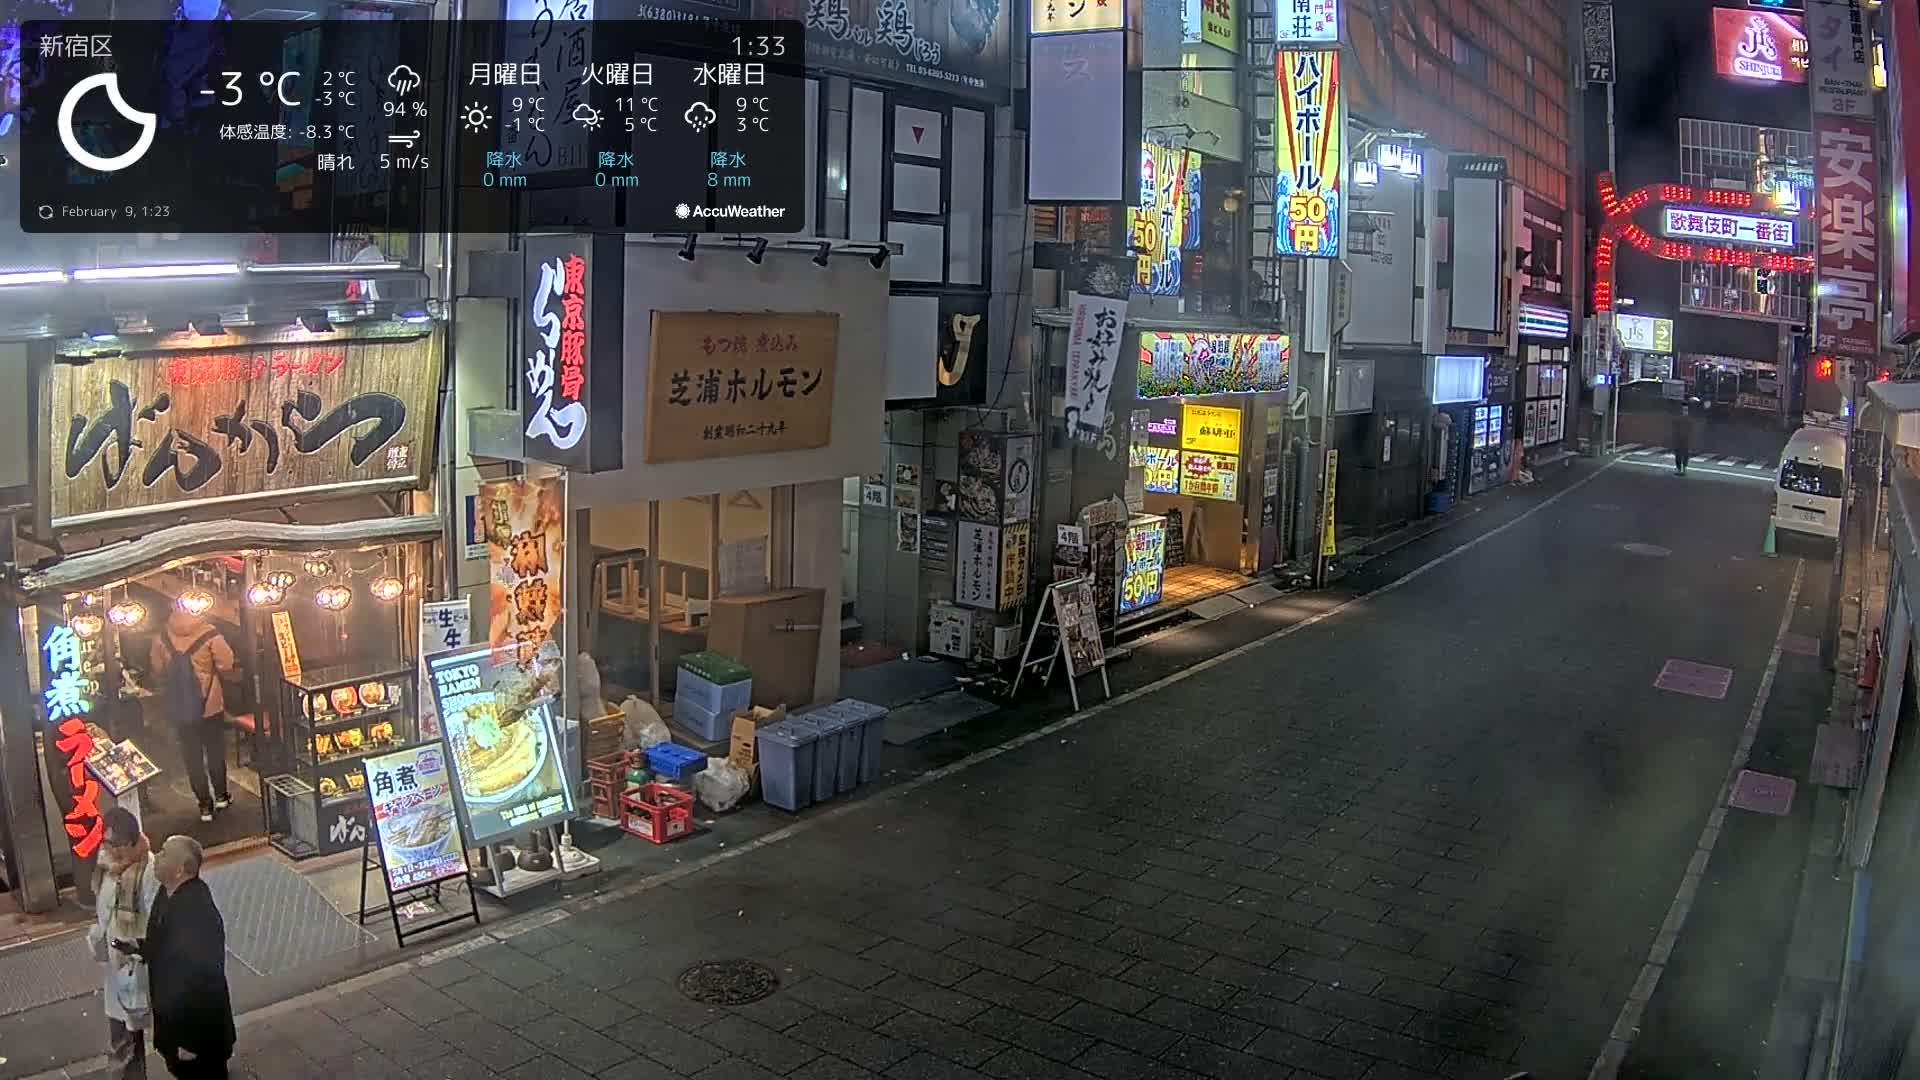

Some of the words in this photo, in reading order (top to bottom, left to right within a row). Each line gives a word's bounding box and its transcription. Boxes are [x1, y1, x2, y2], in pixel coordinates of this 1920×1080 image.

[1589, 65, 1609, 79] 7F
[1296, 54, 1321, 190] ハイボール
[1290, 196, 1327, 223] 50
[1670, 212, 1789, 242] 歌舞伎町一番街
[1295, 224, 1319, 252] 円
[1819, 127, 1875, 330] 安楽亭
[560, 254, 585, 400] 東京豚骨
[669, 367, 823, 407] 芝浦ホルモン
[65, 378, 407, 493] ばんから
[43, 626, 92, 720] 角煮
[435, 663, 480, 685] TOKYO
[438, 676, 482, 697] RAMEN
[55, 718, 104, 858] ラーメン
[373, 765, 418, 797] 角煮
